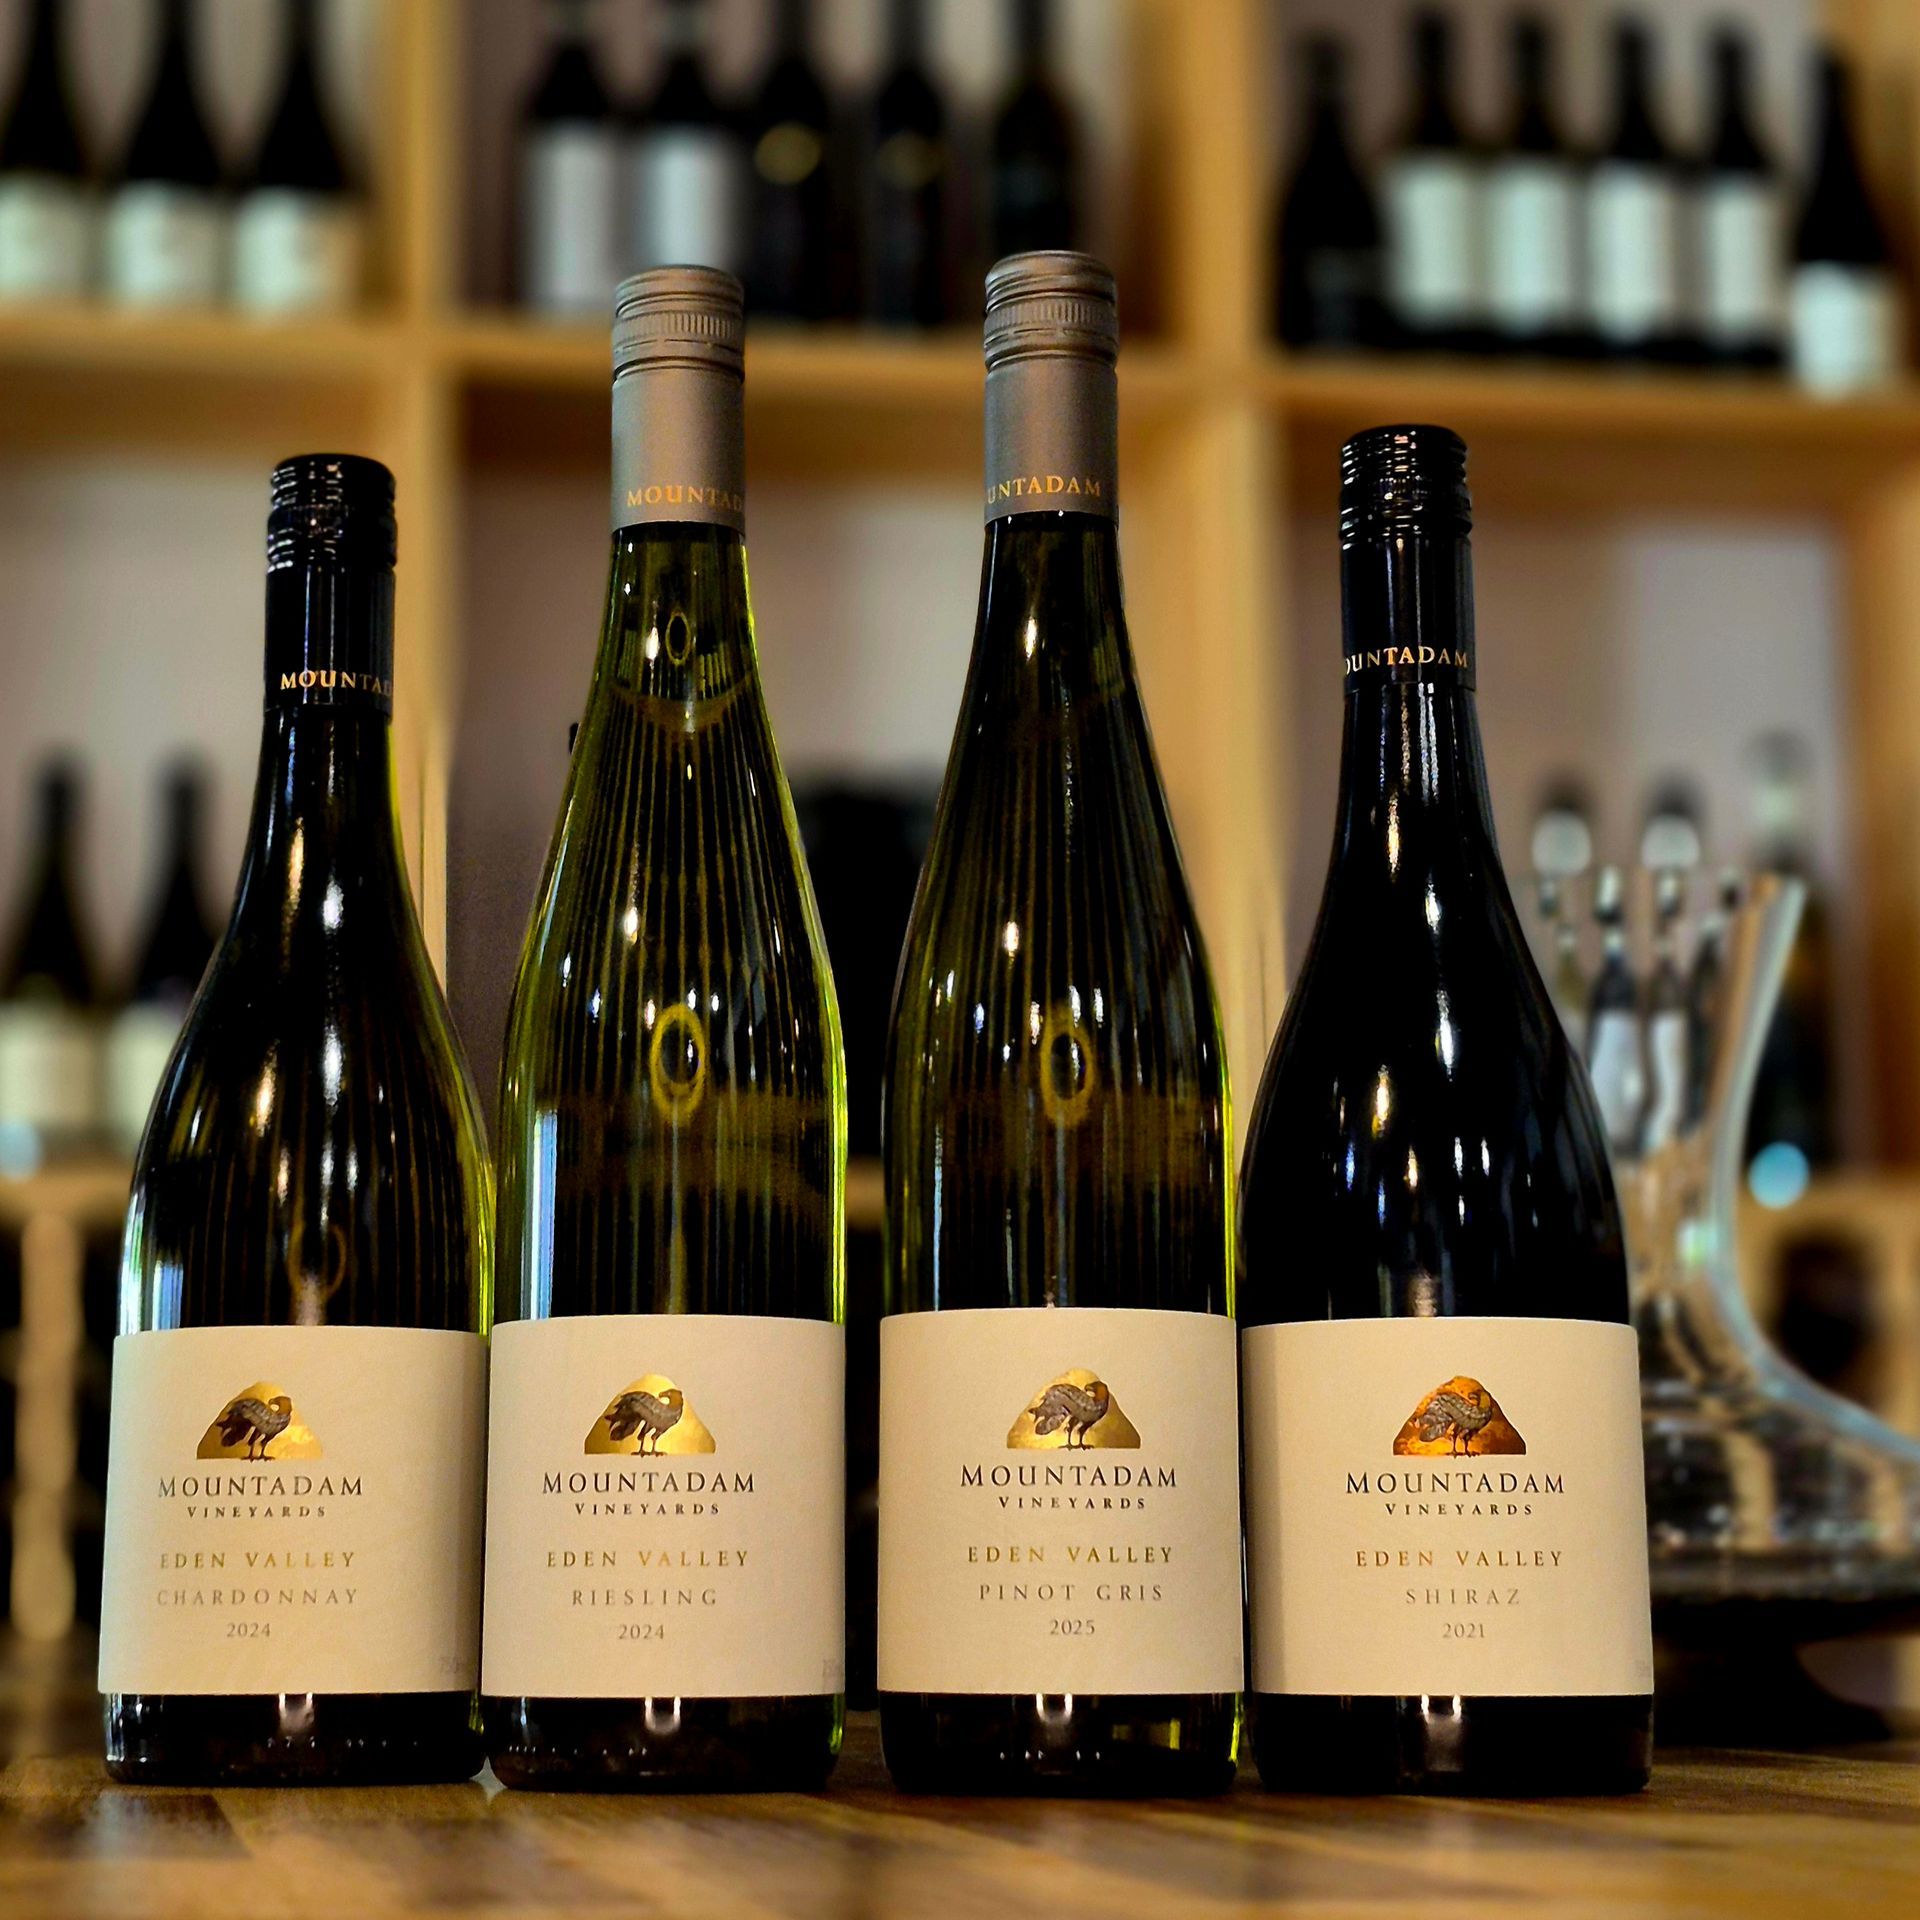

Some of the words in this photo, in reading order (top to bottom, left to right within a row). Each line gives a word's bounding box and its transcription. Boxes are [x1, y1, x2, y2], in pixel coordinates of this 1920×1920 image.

[542, 1471, 755, 1494] MOUNTADAM
[960, 1464, 1177, 1488] MOUNTADAM
[1346, 1471, 1565, 1494] MOUNTADAM
[158, 1475, 363, 1498] MOUNTADAM
[187, 1505, 326, 1518] VINEYARDS
[575, 1502, 721, 1516] VINEYARDS
[999, 1496, 1146, 1510] VINEYARDS
[1385, 1502, 1533, 1516] VINEYARDS
[161, 1552, 225, 1570] EDEN
[245, 1551, 355, 1569] VALLEY
[547, 1550, 617, 1568] EDEN
[638, 1550, 749, 1567] VALLEY
[968, 1546, 1045, 1563] EDEN
[1068, 1546, 1172, 1564] VALLEY
[1356, 1550, 1434, 1568] EDEN
[1455, 1550, 1563, 1567] VALLEY
[156, 1588, 359, 1606] CHARDONNAY
[572, 1589, 717, 1606] RIESLING
[979, 1583, 1076, 1601] PINOT
[1096, 1583, 1163, 1601] GRIS
[1406, 1588, 1520, 1605] SHIRAZ
[226, 1622, 271, 1638] 2024
[618, 1623, 665, 1640] 2024
[1049, 1619, 1096, 1636] 2025
[1442, 1622, 1485, 1639] 2021
